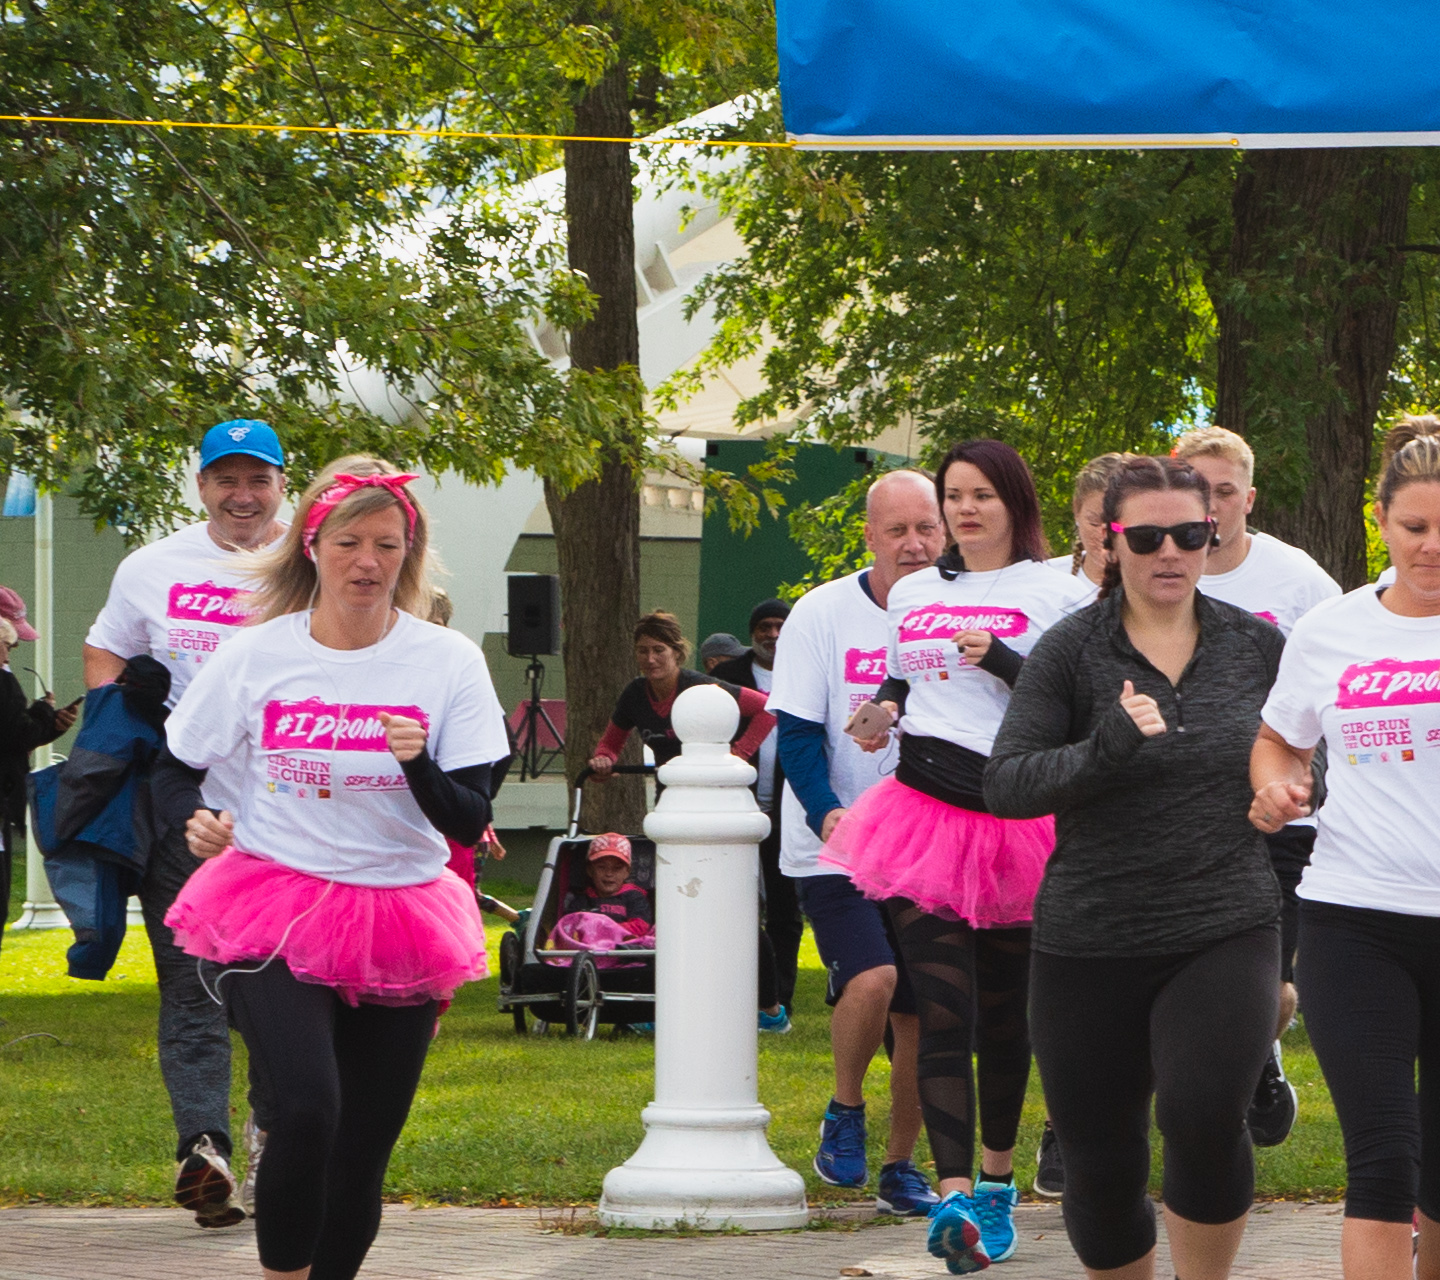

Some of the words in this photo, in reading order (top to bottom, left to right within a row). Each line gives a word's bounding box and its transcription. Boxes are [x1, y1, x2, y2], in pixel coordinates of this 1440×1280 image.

[909, 656, 946, 671] CURE
[1341, 720, 1374, 734] CIBC
[1378, 718, 1410, 731] RUN
[1359, 730, 1412, 747] CURE
[268, 754, 298, 768] CIBC
[300, 760, 331, 773] RUN
[281, 768, 331, 786] CURE
